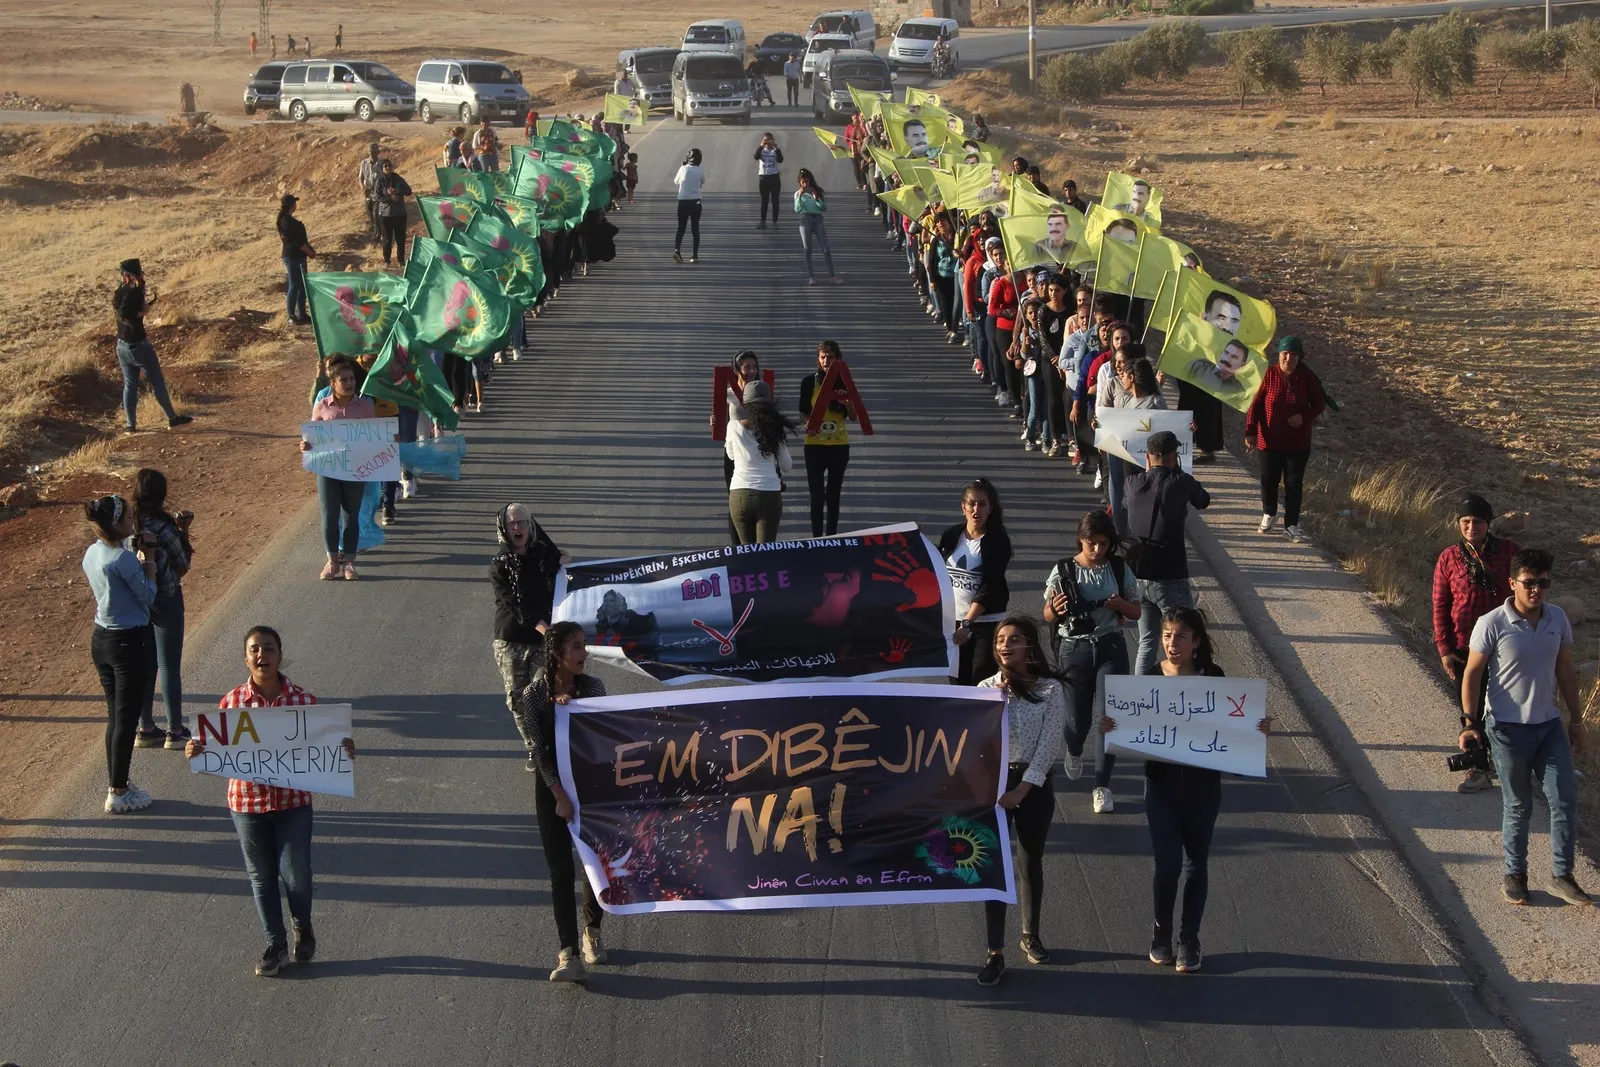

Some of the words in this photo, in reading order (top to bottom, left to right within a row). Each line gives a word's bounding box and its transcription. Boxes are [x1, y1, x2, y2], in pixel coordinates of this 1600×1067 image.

[308, 424, 334, 446] JIN
[340, 421, 381, 442] JIYAN
[672, 549, 720, 567] ÊŞKENCE
[724, 545, 733, 556] Û
[845, 538, 859, 546] RE
[730, 573, 769, 594] BES
[778, 570, 790, 588] E
[692, 598, 754, 655] لا
[1107, 688, 1160, 716] المفروضة
[1168, 690, 1216, 721] للعزلة
[1226, 693, 1247, 717] لا
[198, 711, 260, 746] NA
[284, 709, 307, 741] JI
[1129, 725, 1177, 748] القائد
[1189, 730, 1228, 753] على
[202, 745, 351, 774] DAGIRKERIYE
[615, 731, 700, 786] EM
[720, 707, 968, 782] DIBÊJIN
[726, 783, 846, 863] NA!
[748, 875, 787, 889] Jinên
[795, 873, 849, 887] Ciwan
[856, 874, 872, 885] ên
